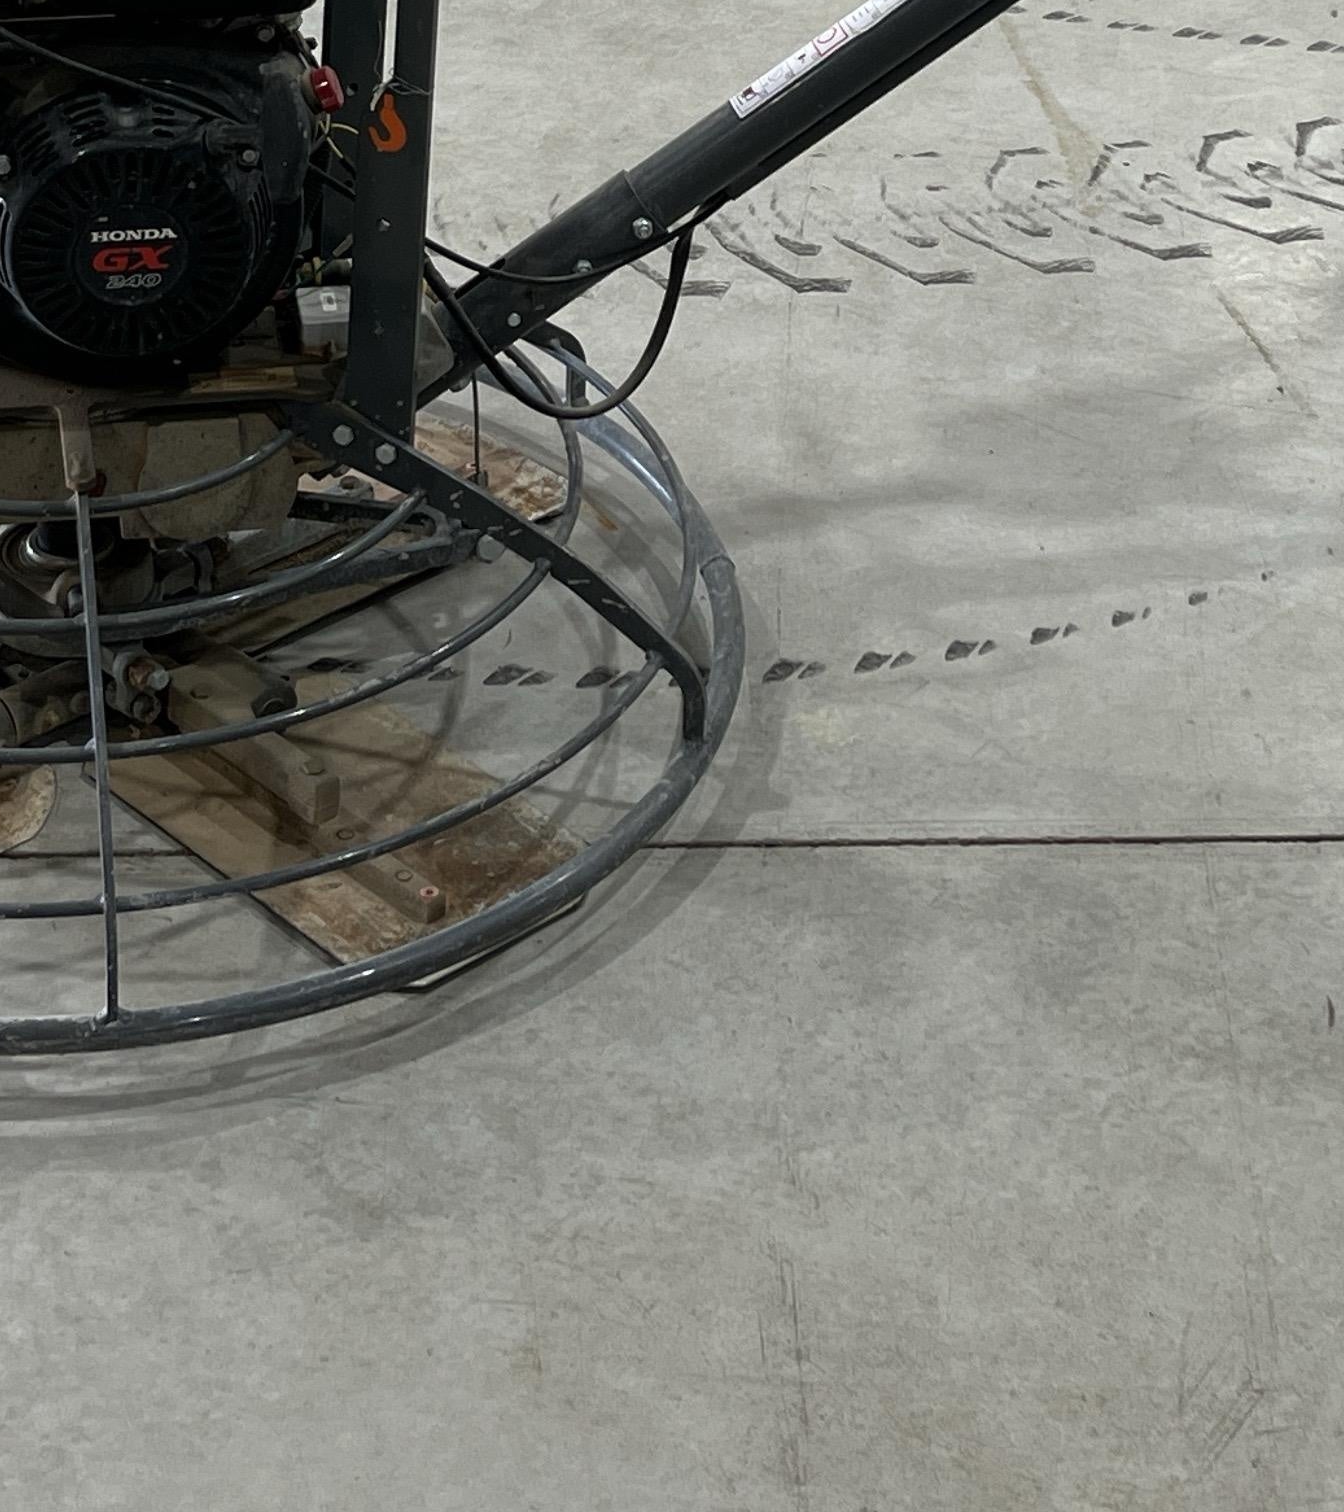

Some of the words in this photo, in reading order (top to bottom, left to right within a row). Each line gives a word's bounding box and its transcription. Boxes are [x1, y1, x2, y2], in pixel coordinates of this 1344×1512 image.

[90, 227, 178, 243] HONDA
[92, 244, 174, 272] GX
[105, 273, 162, 290] 240
